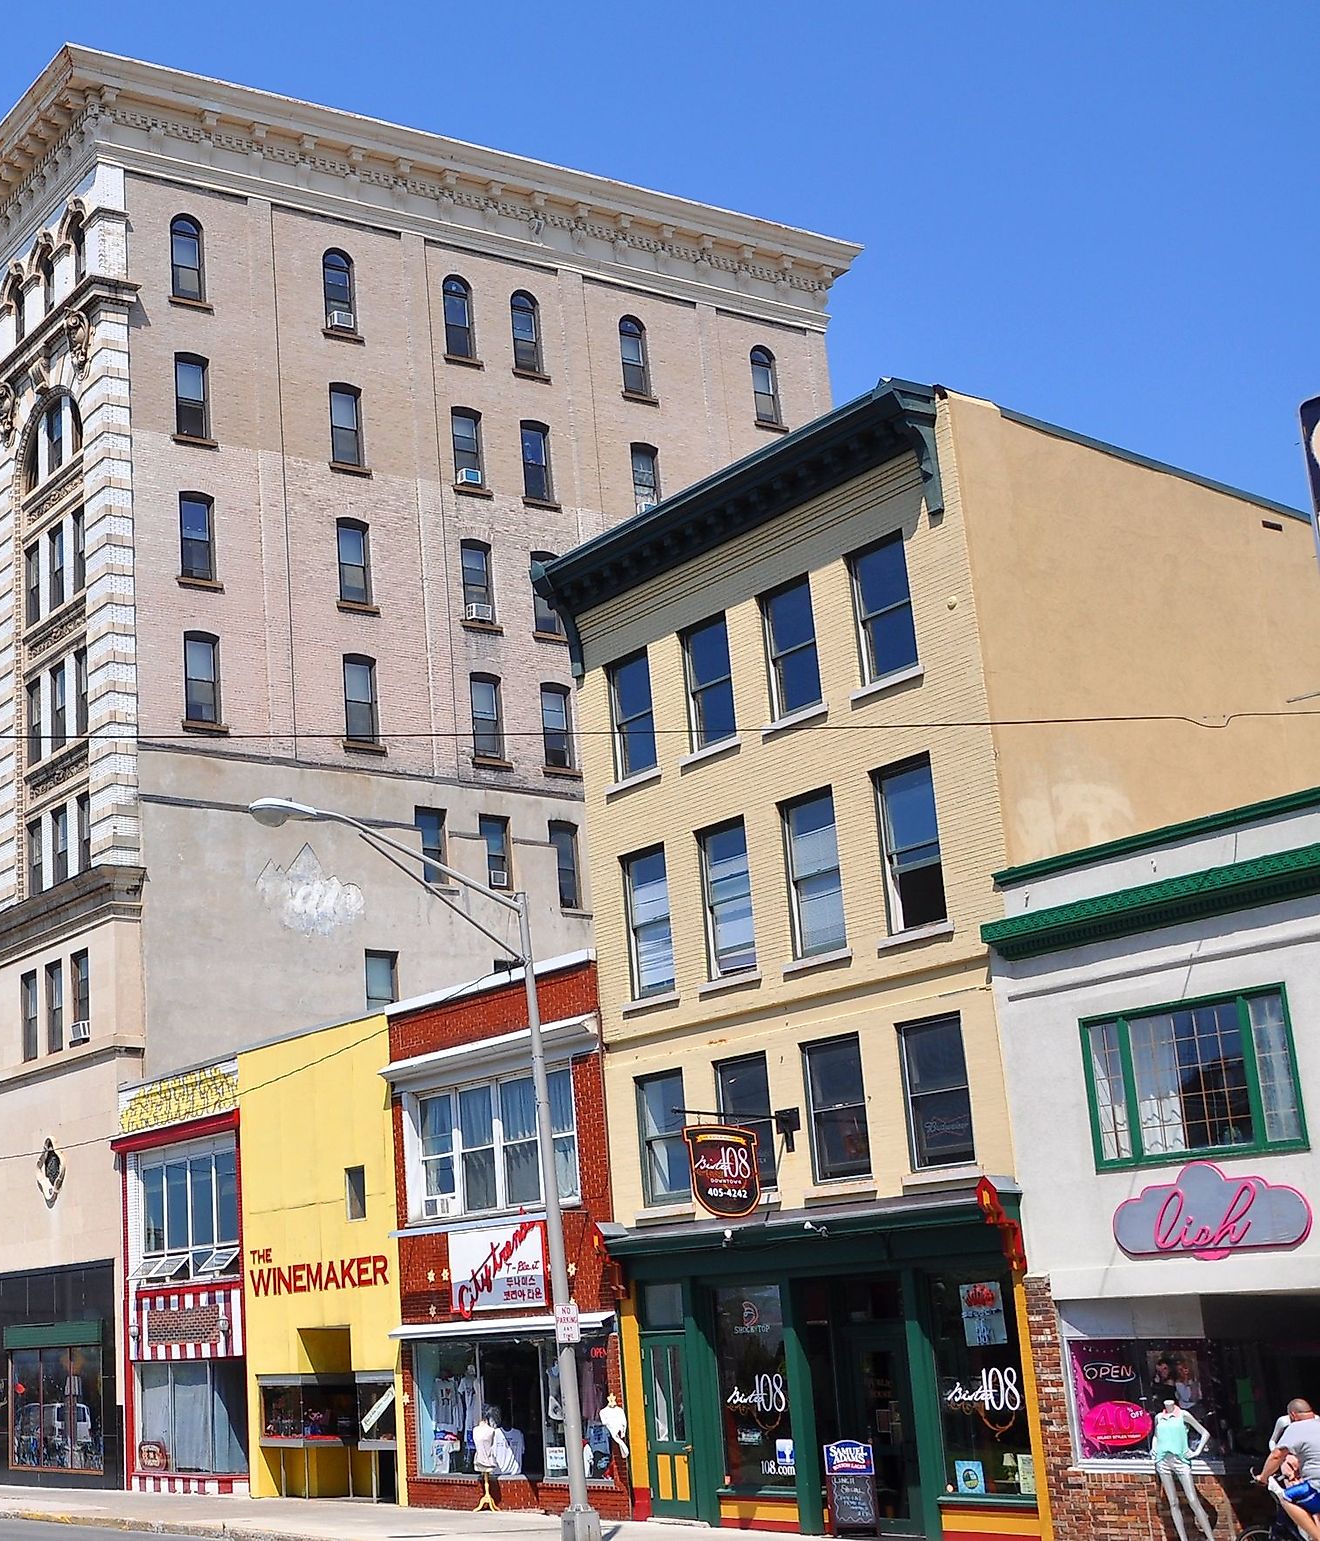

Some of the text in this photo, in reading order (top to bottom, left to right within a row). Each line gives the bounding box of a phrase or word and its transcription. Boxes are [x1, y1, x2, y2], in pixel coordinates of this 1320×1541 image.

[720, 1146, 751, 1179] 108
[707, 1187, 748, 1199] 405-4242
[1154, 1180, 1257, 1249] lish
[249, 1248, 272, 1265] THE
[249, 1254, 390, 1298] WINEMAKER
[561, 1307, 571, 1315] NO
[758, 1325, 770, 1333] TOP
[1085, 1365, 1133, 1380] OPEN
[755, 1373, 786, 1412] 108
[981, 1366, 1021, 1411] 108
[829, 1446, 868, 1457] SAMUEL
[833, 1452, 866, 1465] ADAMS
[761, 1460, 797, 1476] 108.com
